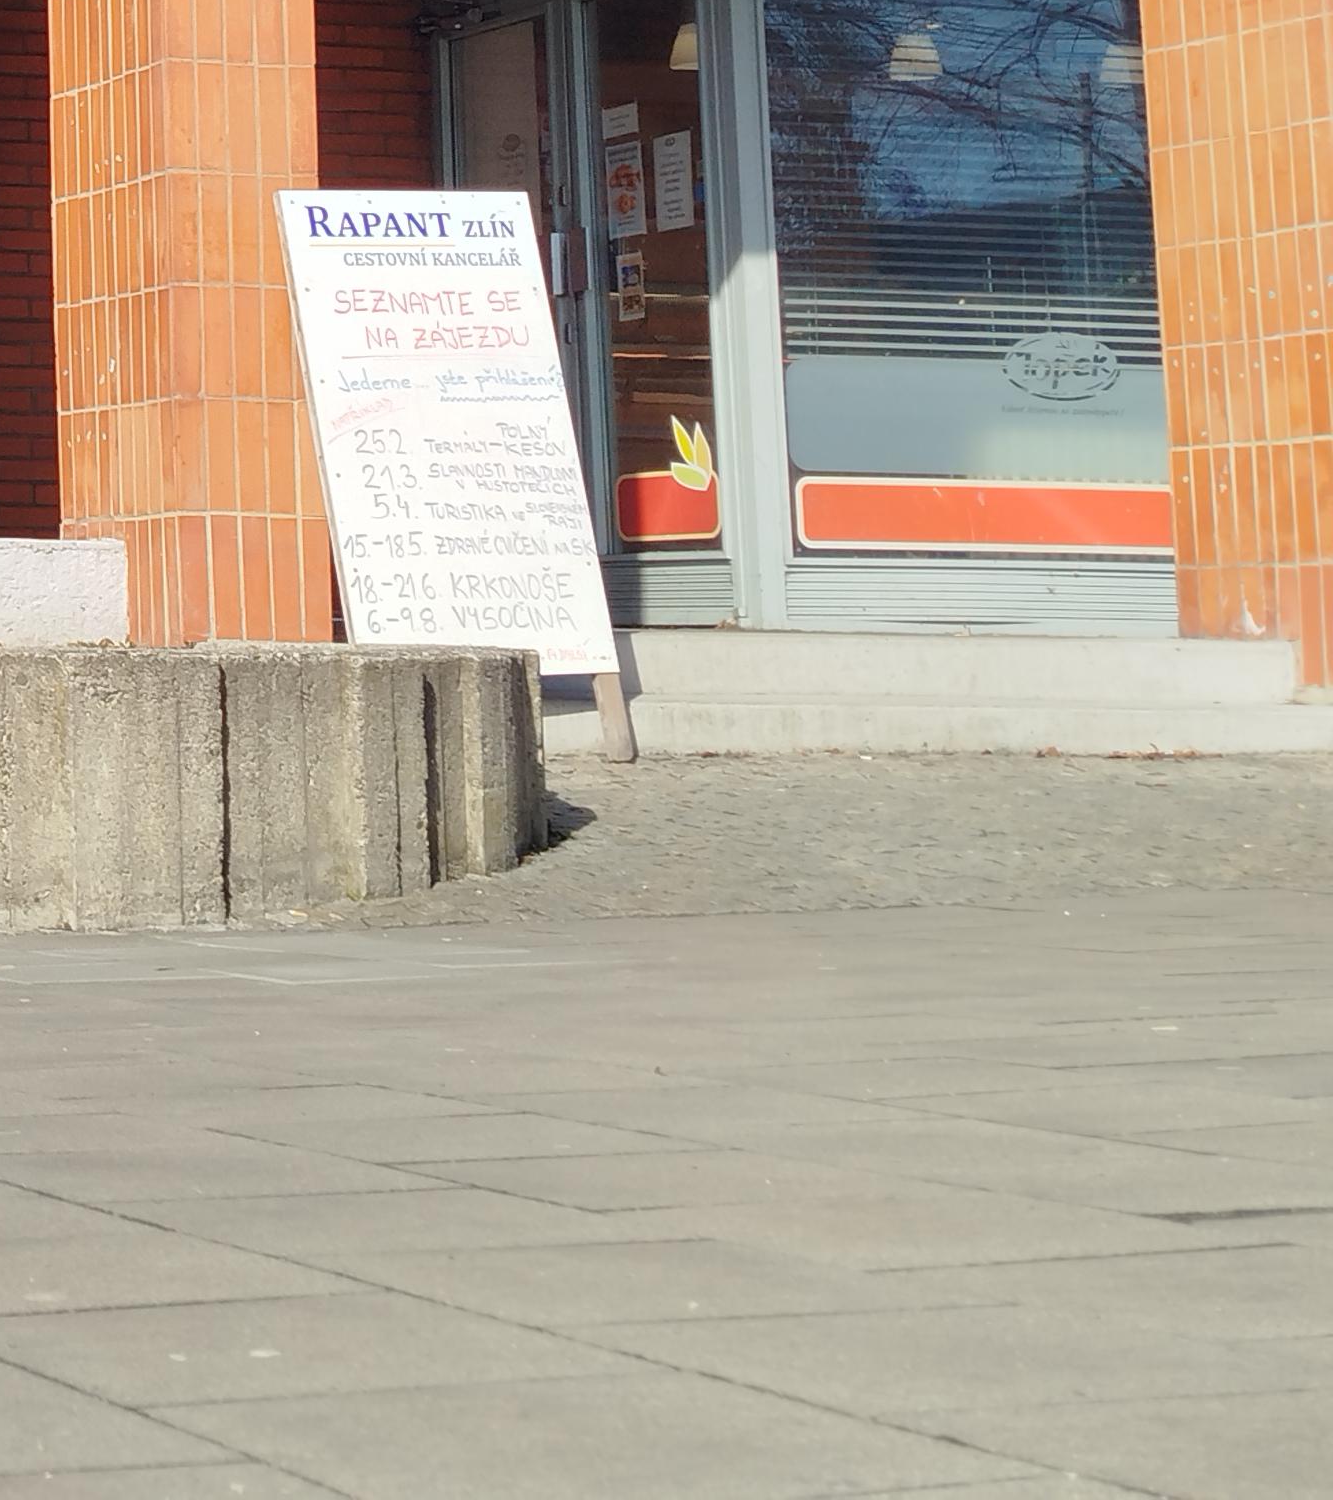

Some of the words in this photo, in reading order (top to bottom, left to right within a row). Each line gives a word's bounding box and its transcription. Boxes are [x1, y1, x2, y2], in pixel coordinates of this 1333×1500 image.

[304, 205, 451, 238] RAPANT
[461, 213, 515, 238] ZLÍN
[343, 247, 428, 266] CESTOVNÍ
[432, 247, 522, 267] KANCELÁŘ
[334, 289, 475, 316] SEZNAMTE
[487, 291, 522, 312] SE
[364, 325, 399, 350] NA
[412, 320, 530, 350] ZÁJEZDU
[423, 501, 508, 523] TURISTIKA
[449, 567, 575, 600] KRKONOŠE
[450, 601, 578, 632] VYSOČINA
